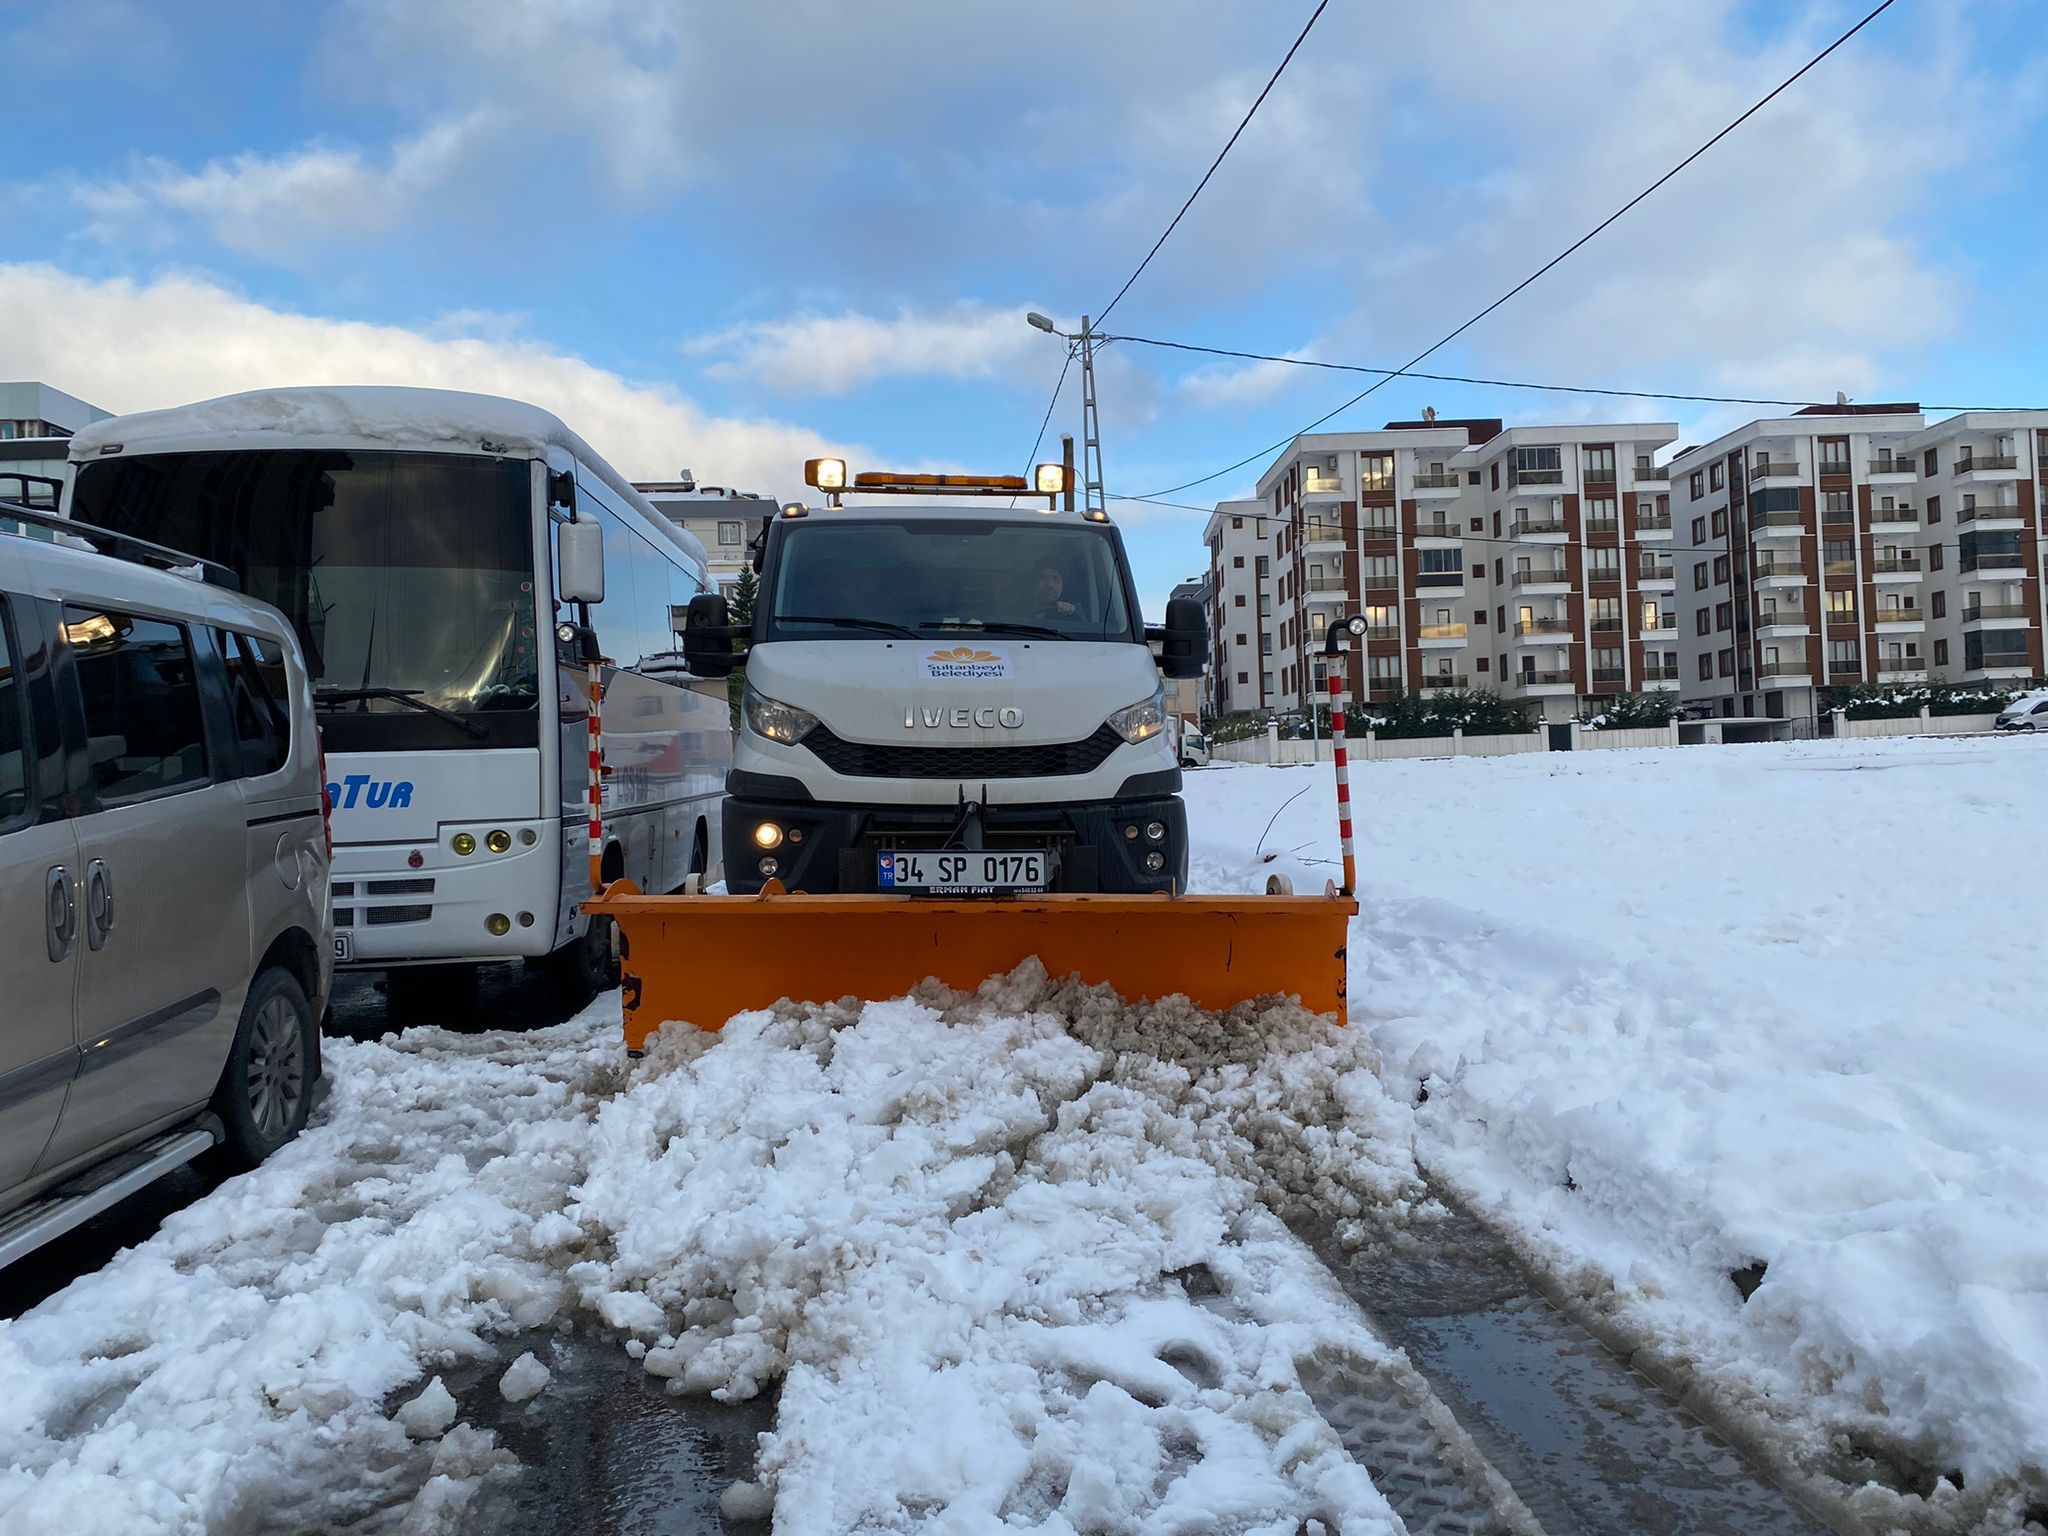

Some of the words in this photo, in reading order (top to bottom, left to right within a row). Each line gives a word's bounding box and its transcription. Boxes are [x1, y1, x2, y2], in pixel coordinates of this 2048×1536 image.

[931, 670, 1002, 678] Belediyesi
[904, 705, 1024, 729] IVECO
[895, 857, 923, 883] 34
[938, 857, 967, 883] SP
[984, 857, 1039, 883] 0176
[883, 872, 893, 880] TR
[971, 886, 995, 894] FIAT
